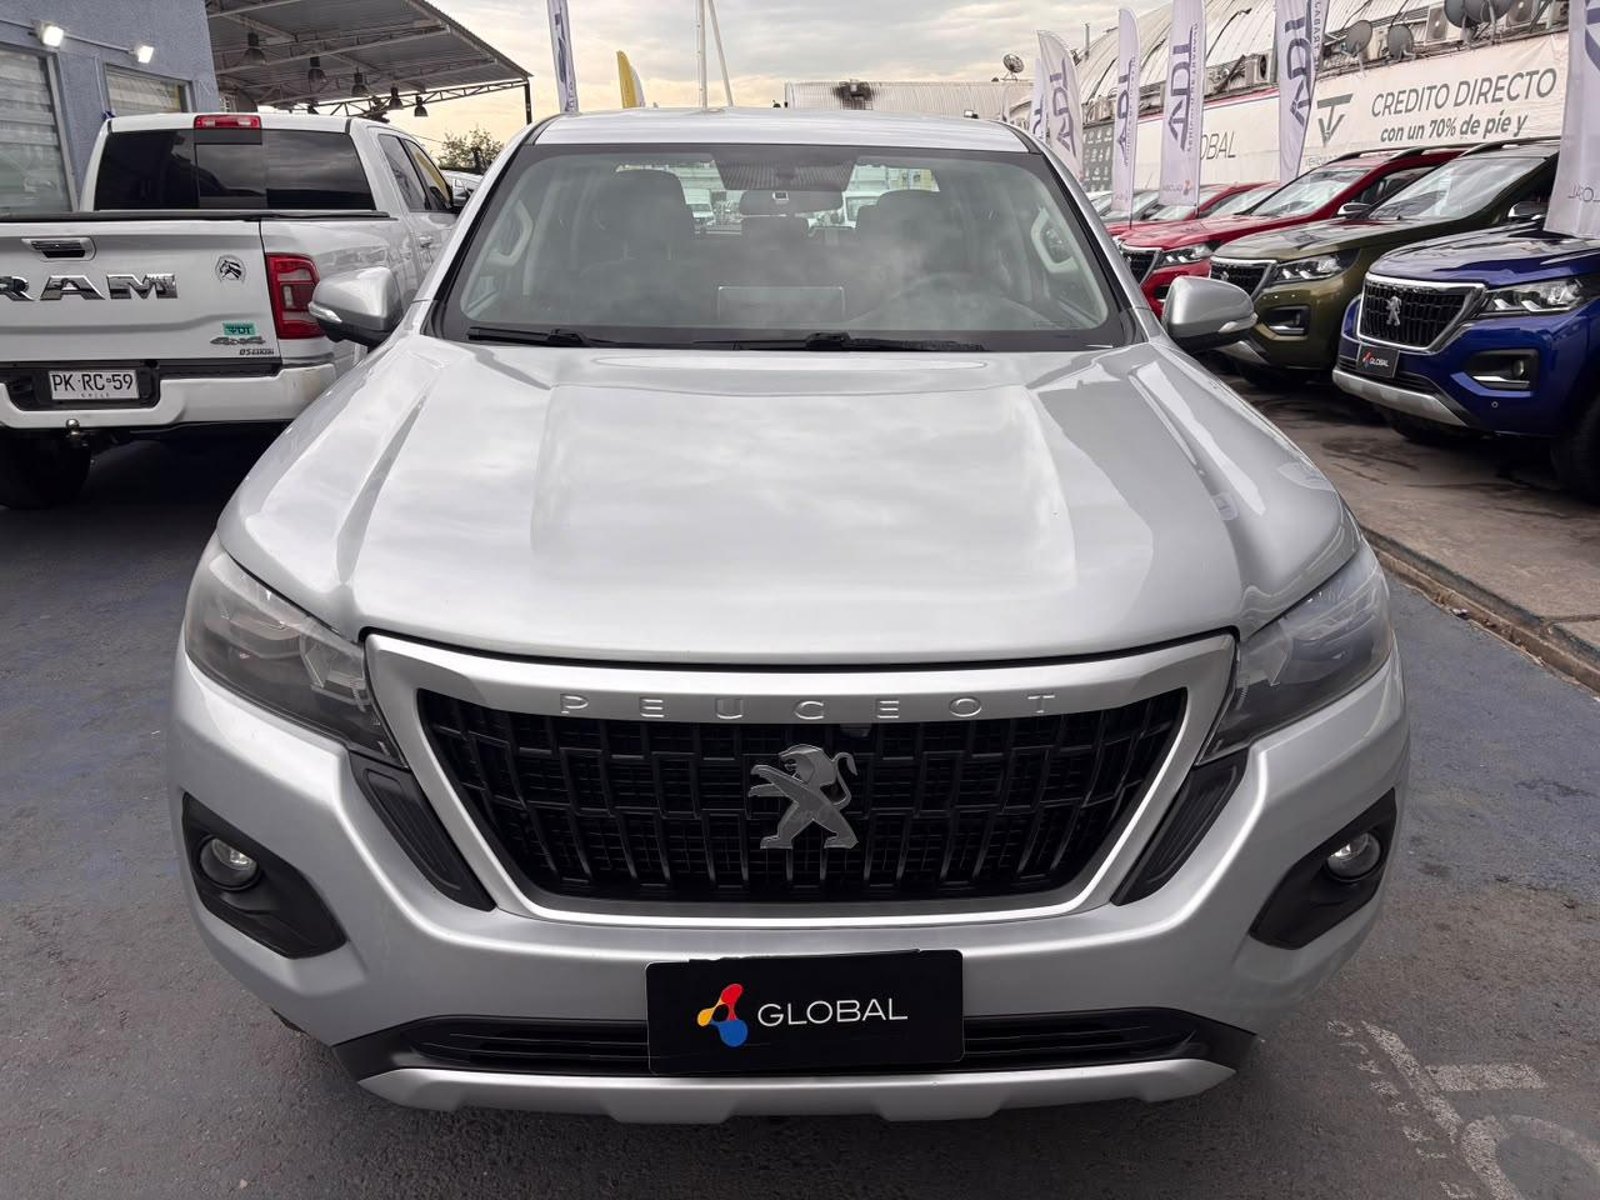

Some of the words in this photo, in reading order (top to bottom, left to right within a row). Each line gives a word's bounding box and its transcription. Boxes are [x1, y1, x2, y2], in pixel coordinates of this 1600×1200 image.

[1371, 83, 1450, 118] CREDITO
[1453, 68, 1557, 108] DIRECTO
[1380, 126, 1404, 143] con
[1407, 123, 1425, 139] un
[1428, 117, 1456, 138] 70%
[1459, 114, 1481, 136] de
[1513, 115, 1528, 137] y
[0, 274, 178, 300] RAM
[560, 693, 1056, 720] PEUGEOT
[757, 998, 909, 1027] GLOBAL
